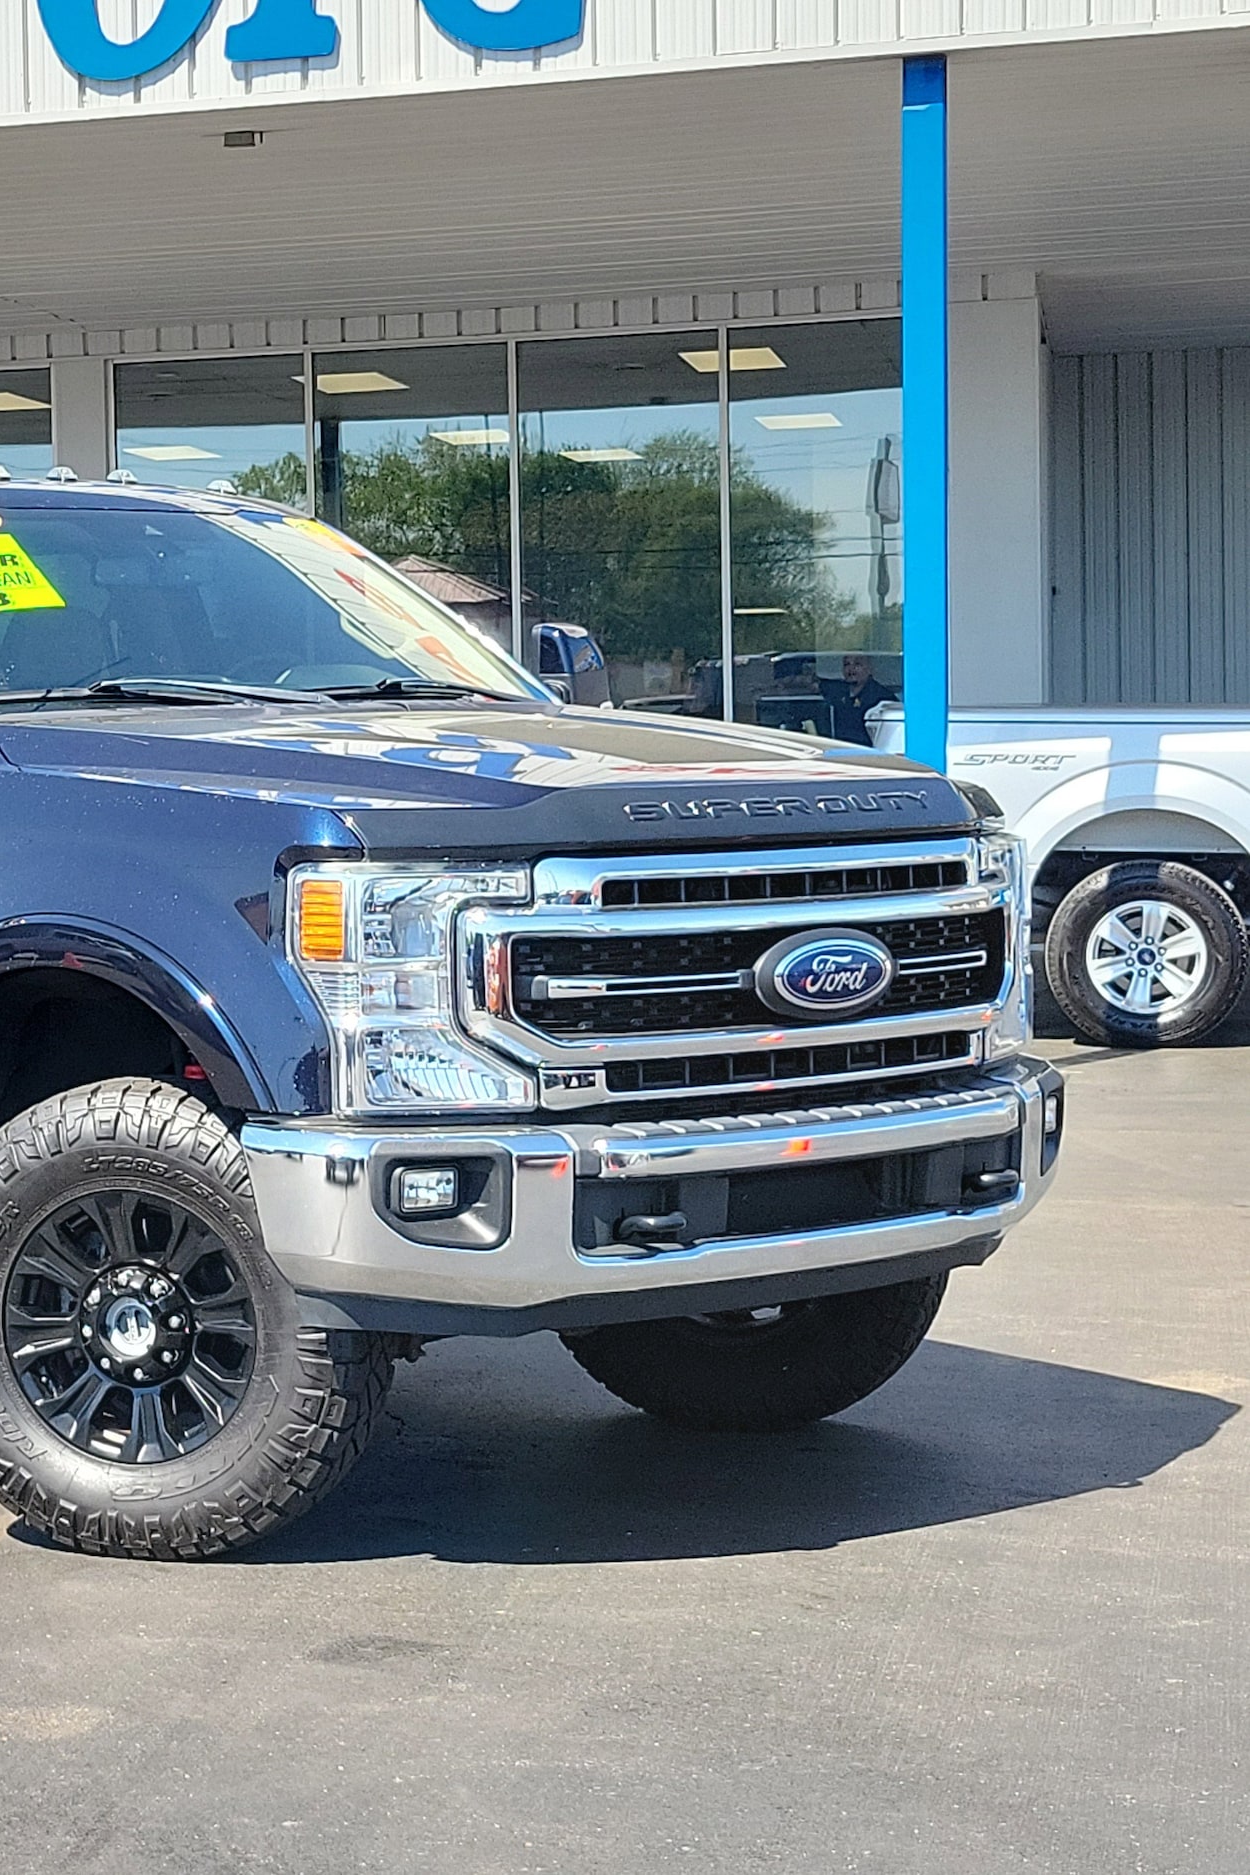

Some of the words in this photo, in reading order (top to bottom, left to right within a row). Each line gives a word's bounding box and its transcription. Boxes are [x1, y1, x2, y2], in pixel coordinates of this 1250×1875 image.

[953, 754, 1077, 765] SPORT
[623, 796, 814, 821] SUPER
[814, 790, 928, 813] DUTY
[806, 955, 868, 993] Ford
